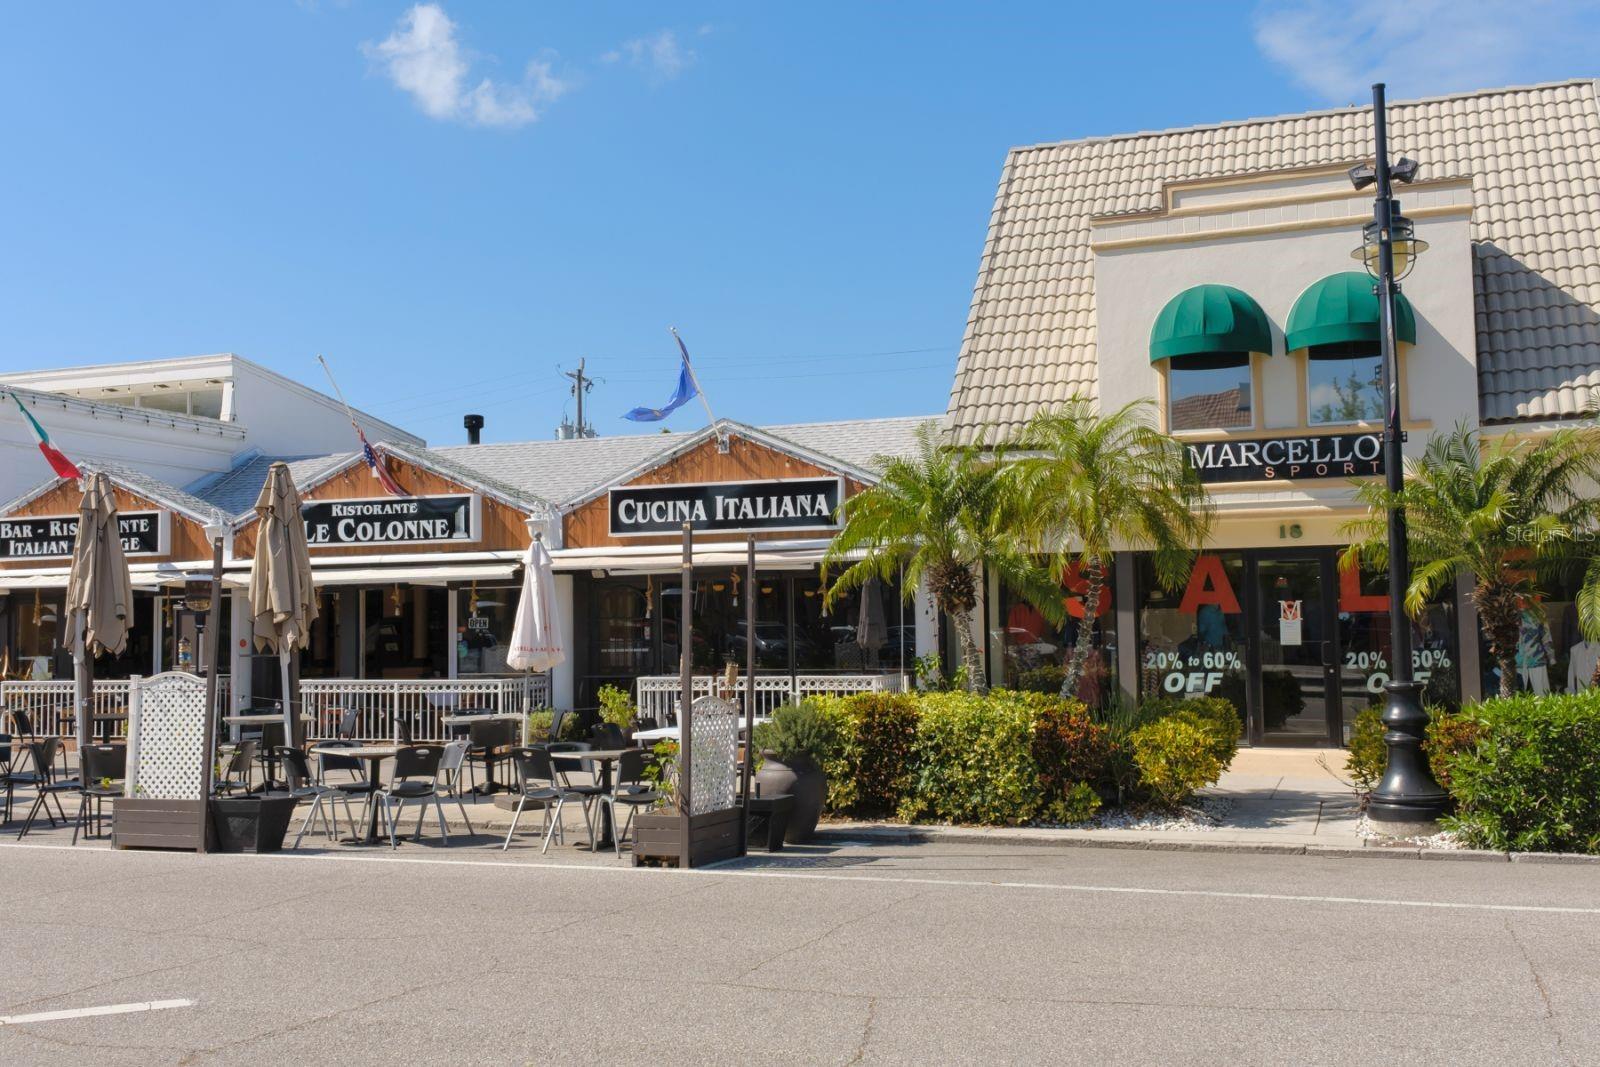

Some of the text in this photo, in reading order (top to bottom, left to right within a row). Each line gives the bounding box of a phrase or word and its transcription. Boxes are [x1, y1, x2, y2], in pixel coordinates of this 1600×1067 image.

[1188, 435, 1381, 469] MARCELLO
[1265, 461, 1380, 478] SPORT
[331, 503, 418, 517] RISTORANTE
[618, 494, 831, 524] CUCINA ITALIANA
[0, 523, 32, 539] BAR
[304, 518, 449, 543] LE COLONNE
[1279, 524, 1303, 539] 18
[9, 540, 69, 556] ITALIAN
[469, 618, 488, 628] OPEN
[1146, 652, 1241, 669] 20% to 60%
[1346, 650, 1451, 669] 20% 60%
[1164, 672, 1223, 693] OFF
